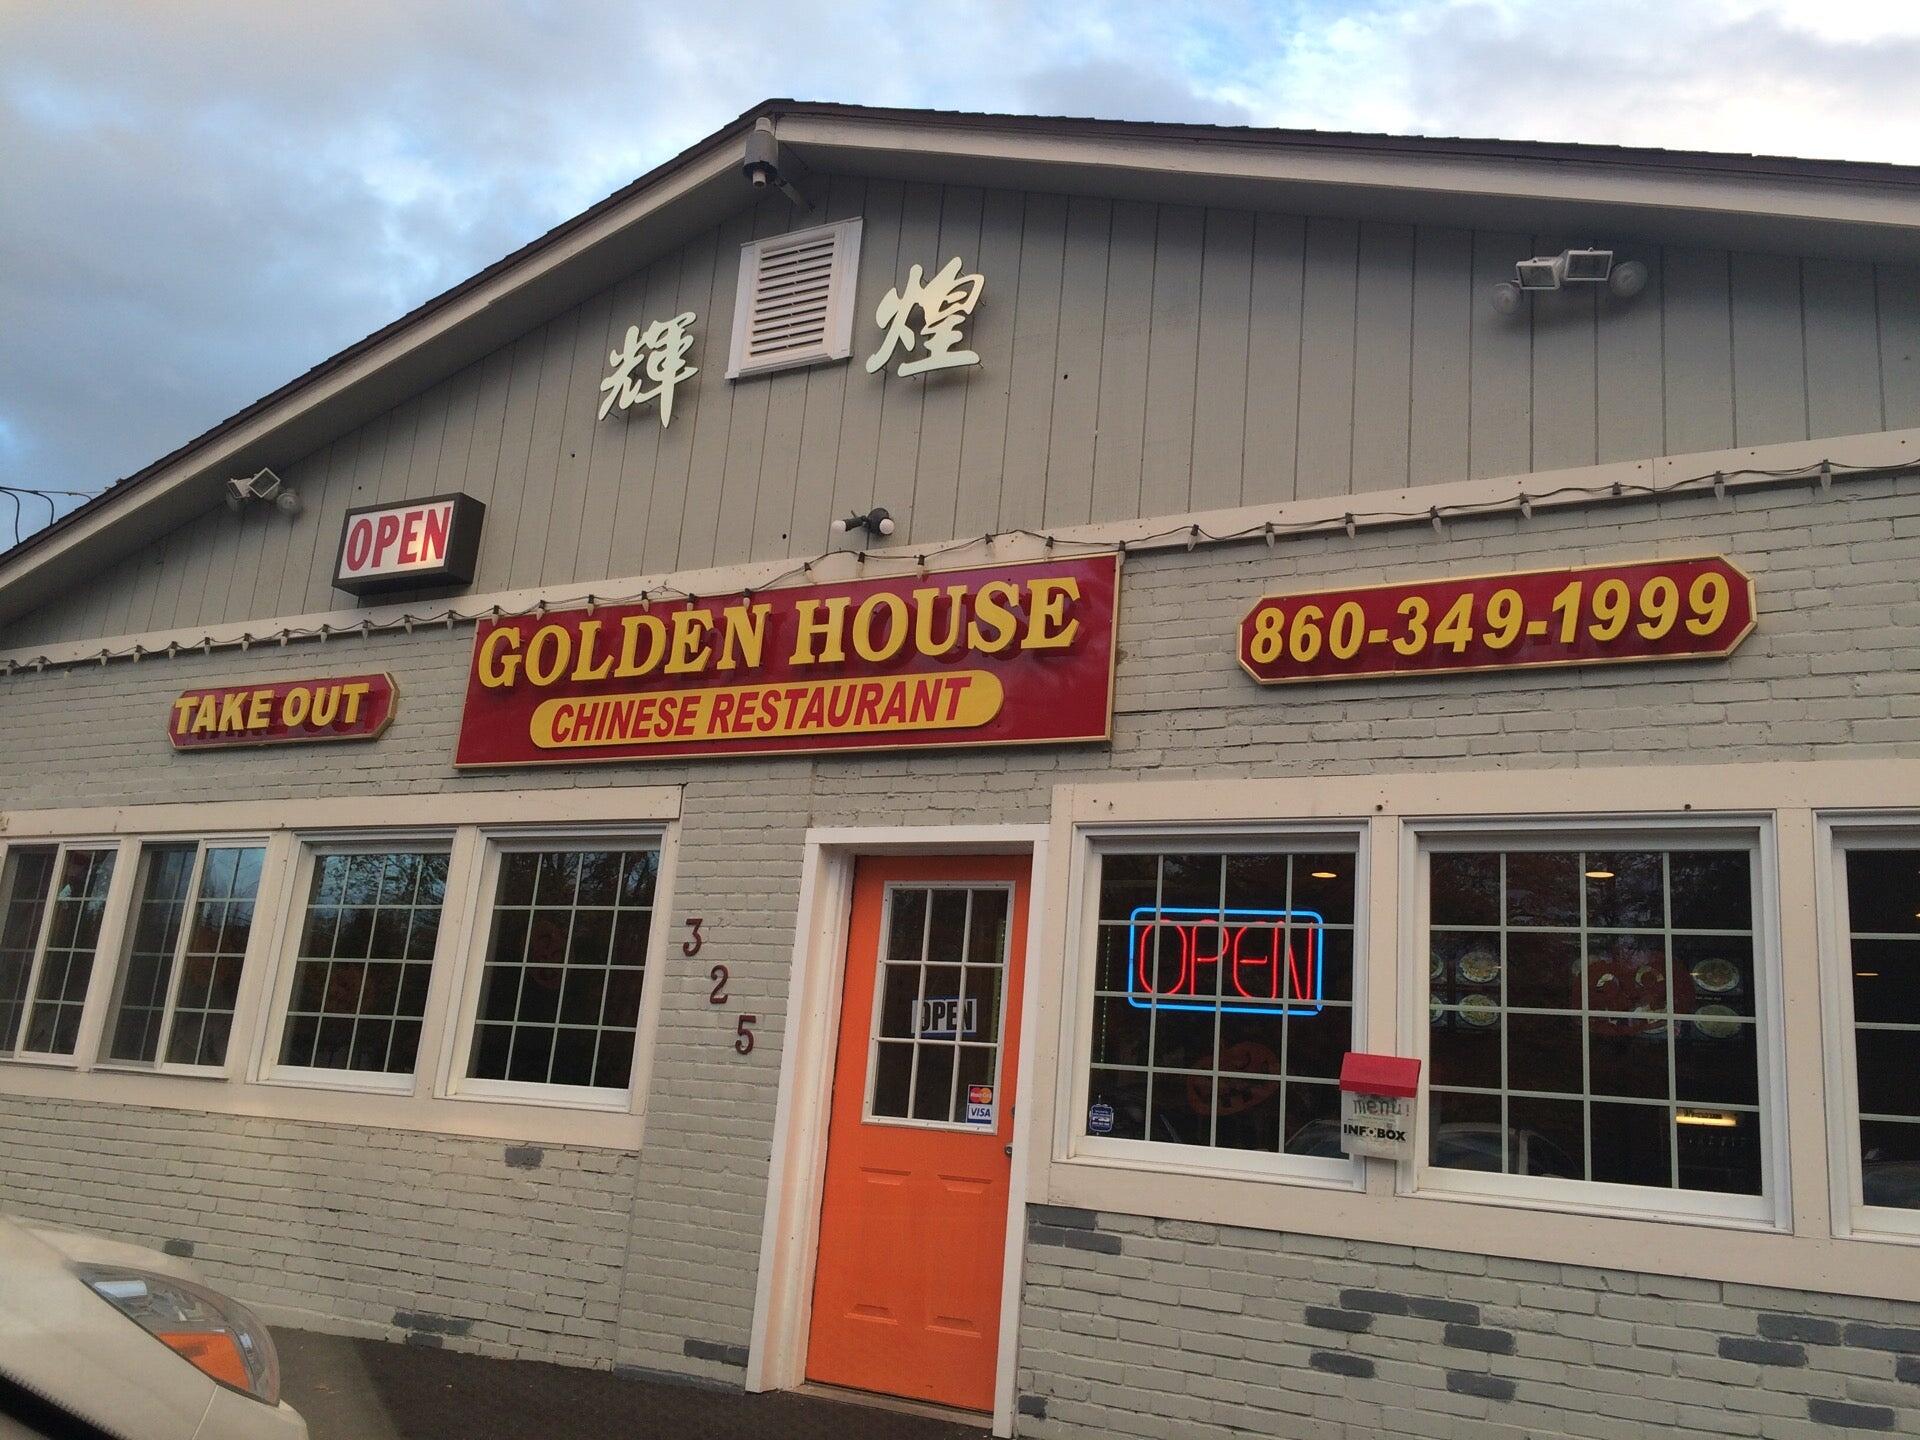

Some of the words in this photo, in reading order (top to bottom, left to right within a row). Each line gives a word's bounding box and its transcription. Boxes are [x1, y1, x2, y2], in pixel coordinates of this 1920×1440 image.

[346, 507, 452, 572] OPEN
[477, 602, 772, 689] GOLDEN
[788, 576, 1081, 666] HOUSE
[1249, 571, 1731, 665] 860-349-1999
[174, 689, 275, 735] TAKE
[281, 682, 370, 728] OUT
[550, 694, 701, 744] CHINESE
[706, 676, 973, 735] RESTAURANT
[1138, 919, 1315, 1001] OPEN
[971, 1107, 991, 1118] VISA
